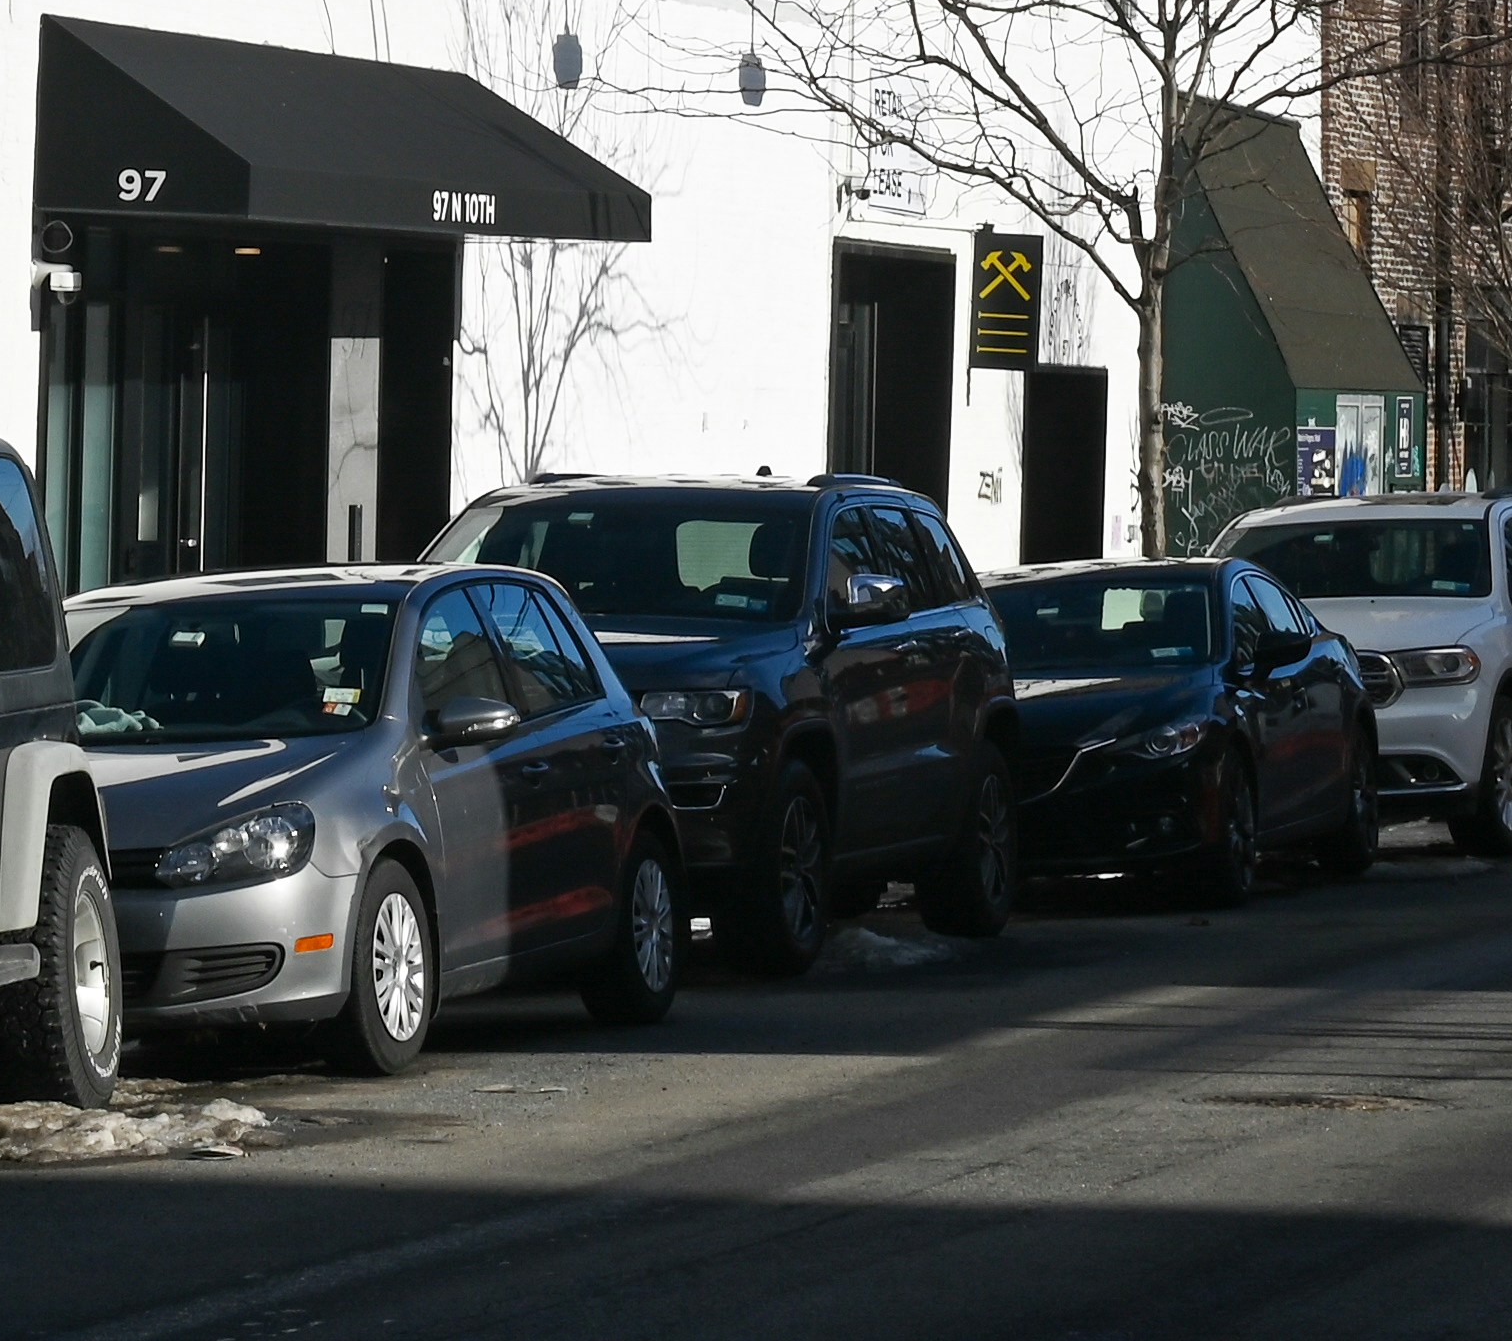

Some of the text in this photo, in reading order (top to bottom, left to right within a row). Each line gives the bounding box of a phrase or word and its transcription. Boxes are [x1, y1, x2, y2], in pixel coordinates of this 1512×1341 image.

[117, 169, 168, 202] 97
[432, 190, 495, 225] 97 N 10TH
[1166, 423, 1292, 467] CLASS WAR
